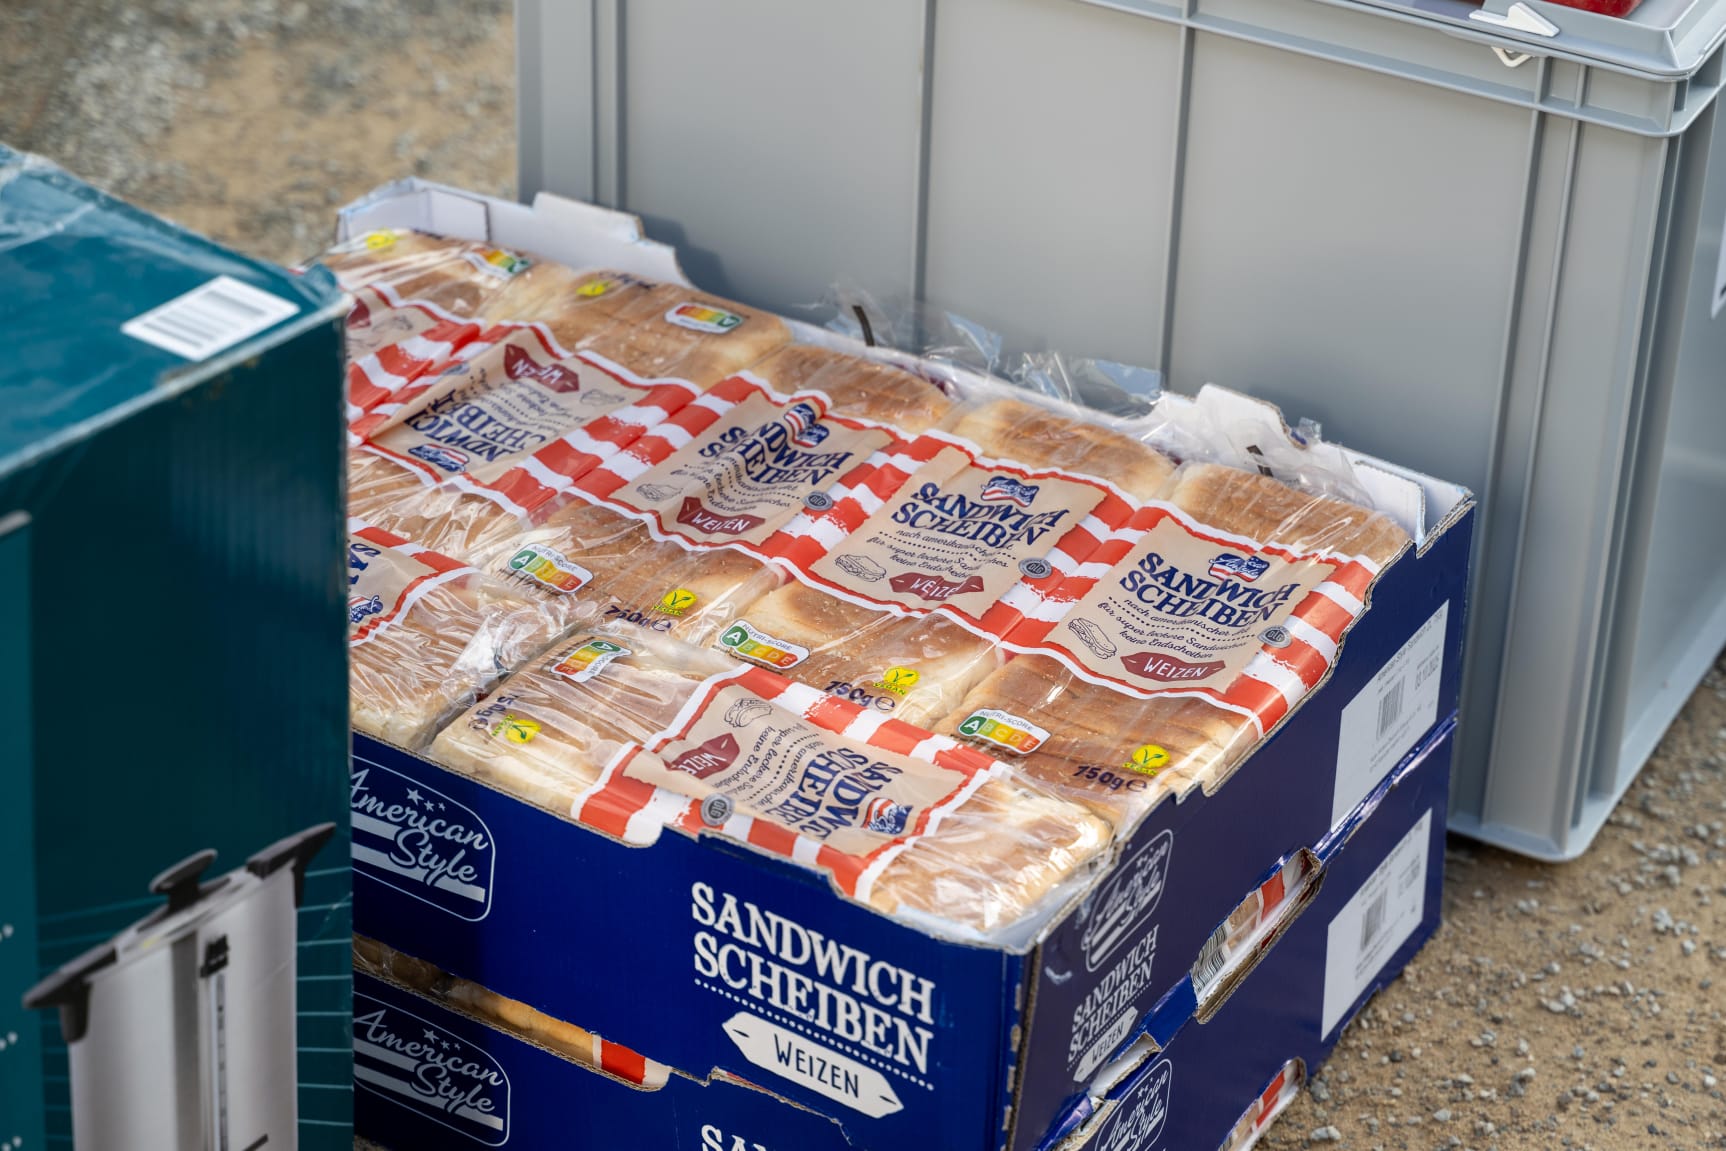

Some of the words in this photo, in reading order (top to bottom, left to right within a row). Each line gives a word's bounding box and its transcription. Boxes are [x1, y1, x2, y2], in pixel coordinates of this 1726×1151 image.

[512, 359, 563, 384] WEEN
[403, 410, 516, 462] NDWIC
[698, 438, 834, 486] SHEIBEN
[720, 422, 854, 470] SNDWICH
[1143, 657, 1208, 678] WEIZEN
[979, 710, 1034, 731] NUTRI-SCORE
[677, 752, 727, 776] WEIZE
[765, 748, 869, 826] SCHEIBE
[1073, 765, 1125, 791] 750g
[351, 768, 489, 850] American
[799, 761, 904, 840] SANDWIC
[390, 829, 478, 886] Style
[691, 881, 936, 1026] SANDWICH
[1072, 924, 1160, 1034] SANDWICH
[693, 931, 935, 1075] SCHEIBEN
[1067, 953, 1156, 1064] SCHEIBEN
[353, 1009, 504, 1087] American
[773, 1032, 860, 1099] WEIZEN
[1091, 1021, 1125, 1065] WEIZEN
[411, 1063, 496, 1113] Style
